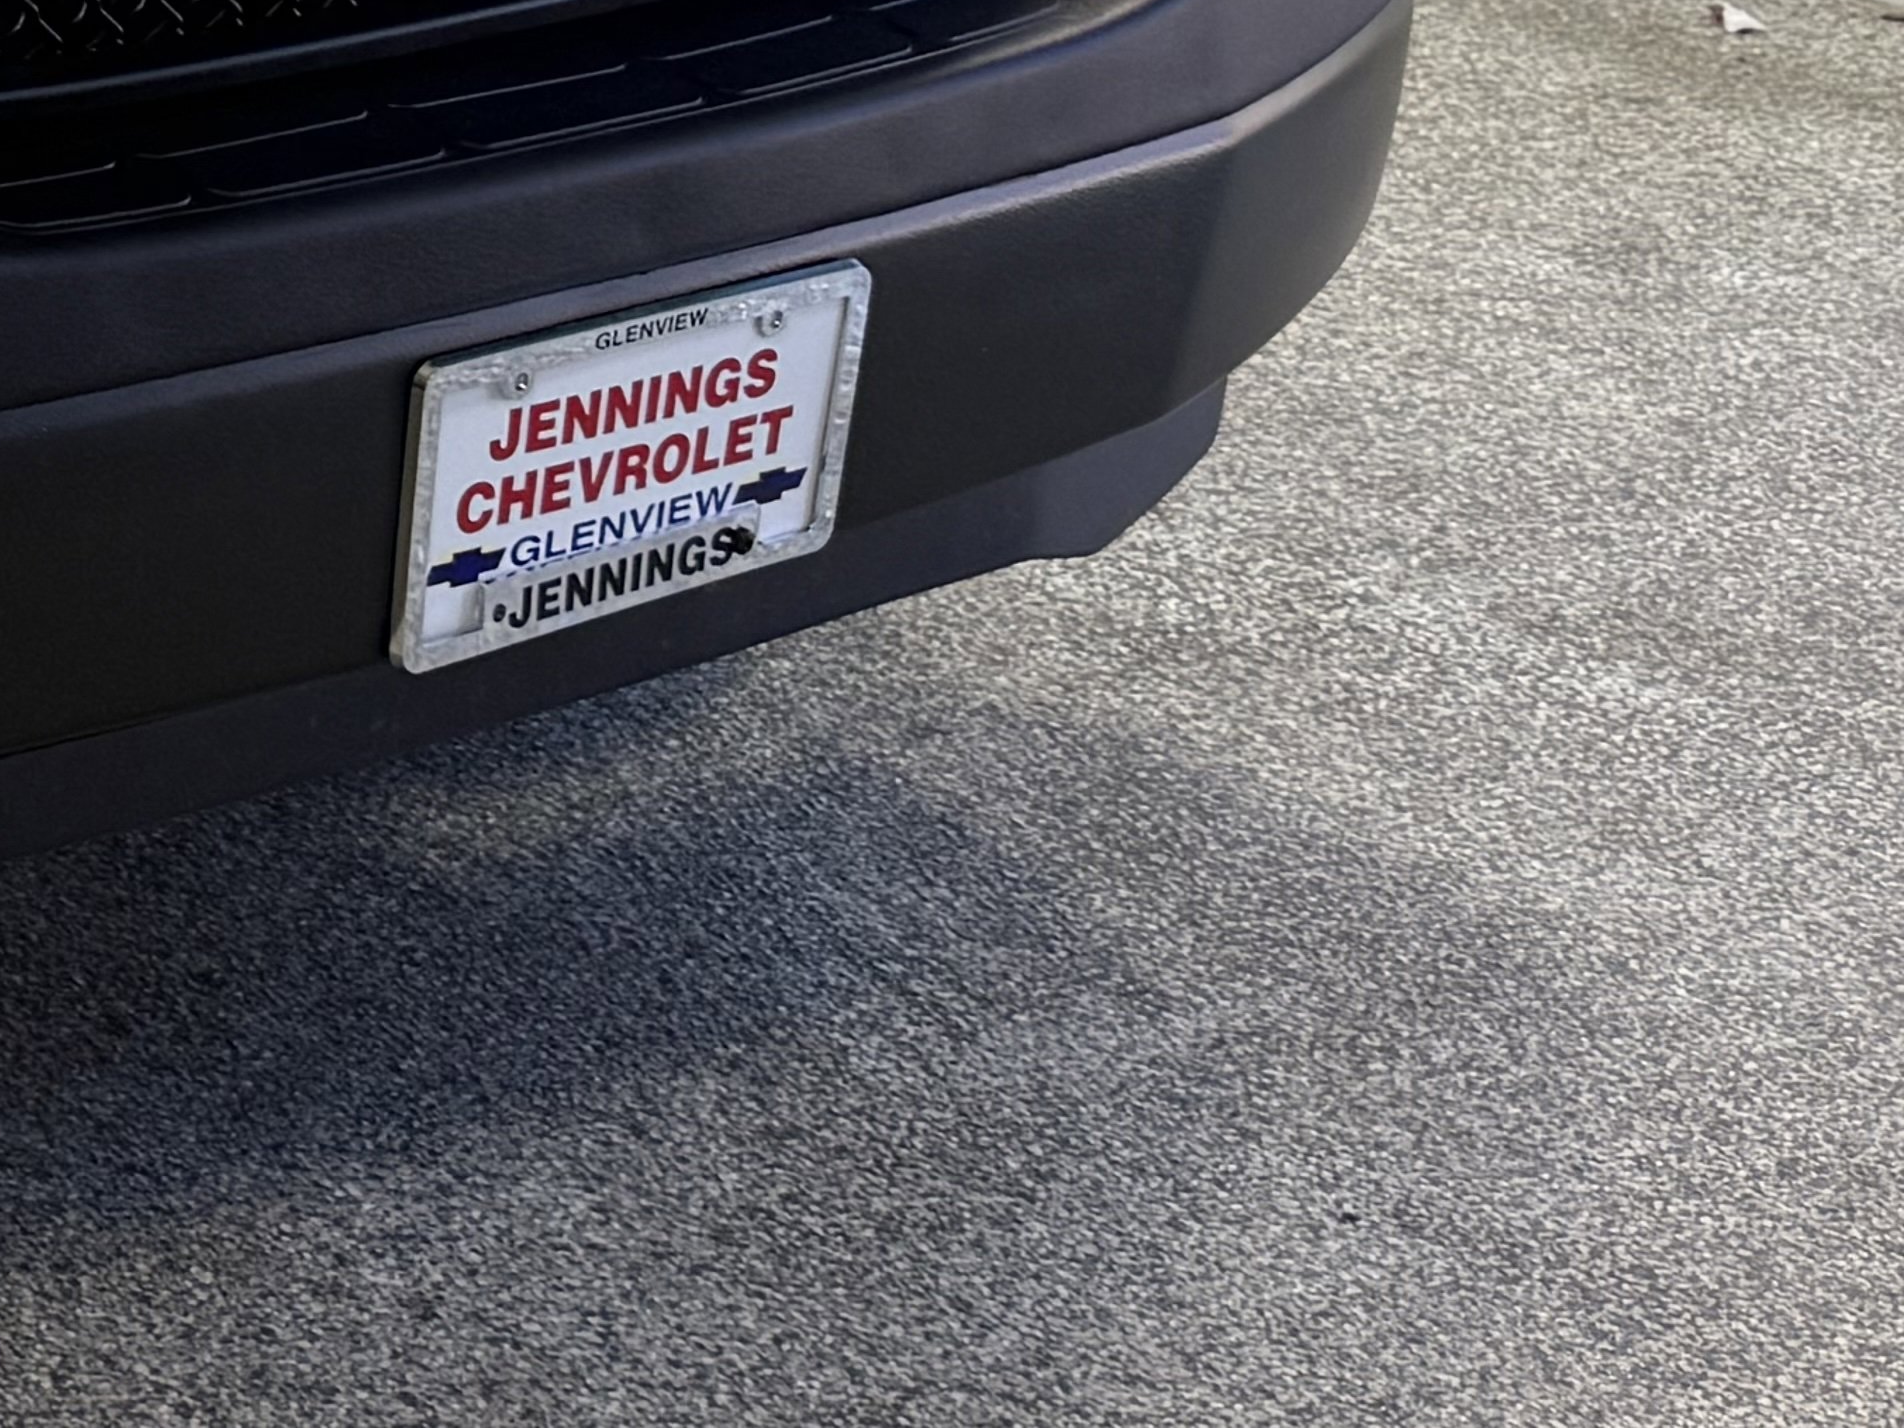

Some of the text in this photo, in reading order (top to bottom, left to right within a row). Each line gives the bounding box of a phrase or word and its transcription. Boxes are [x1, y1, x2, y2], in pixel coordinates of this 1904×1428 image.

[595, 307, 709, 350] GLENVIEW
[489, 348, 779, 462] JENNINGS
[456, 405, 794, 534] CHEVROLET
[509, 482, 733, 567] GLENVIEW
[508, 527, 735, 628] JENNINGS
